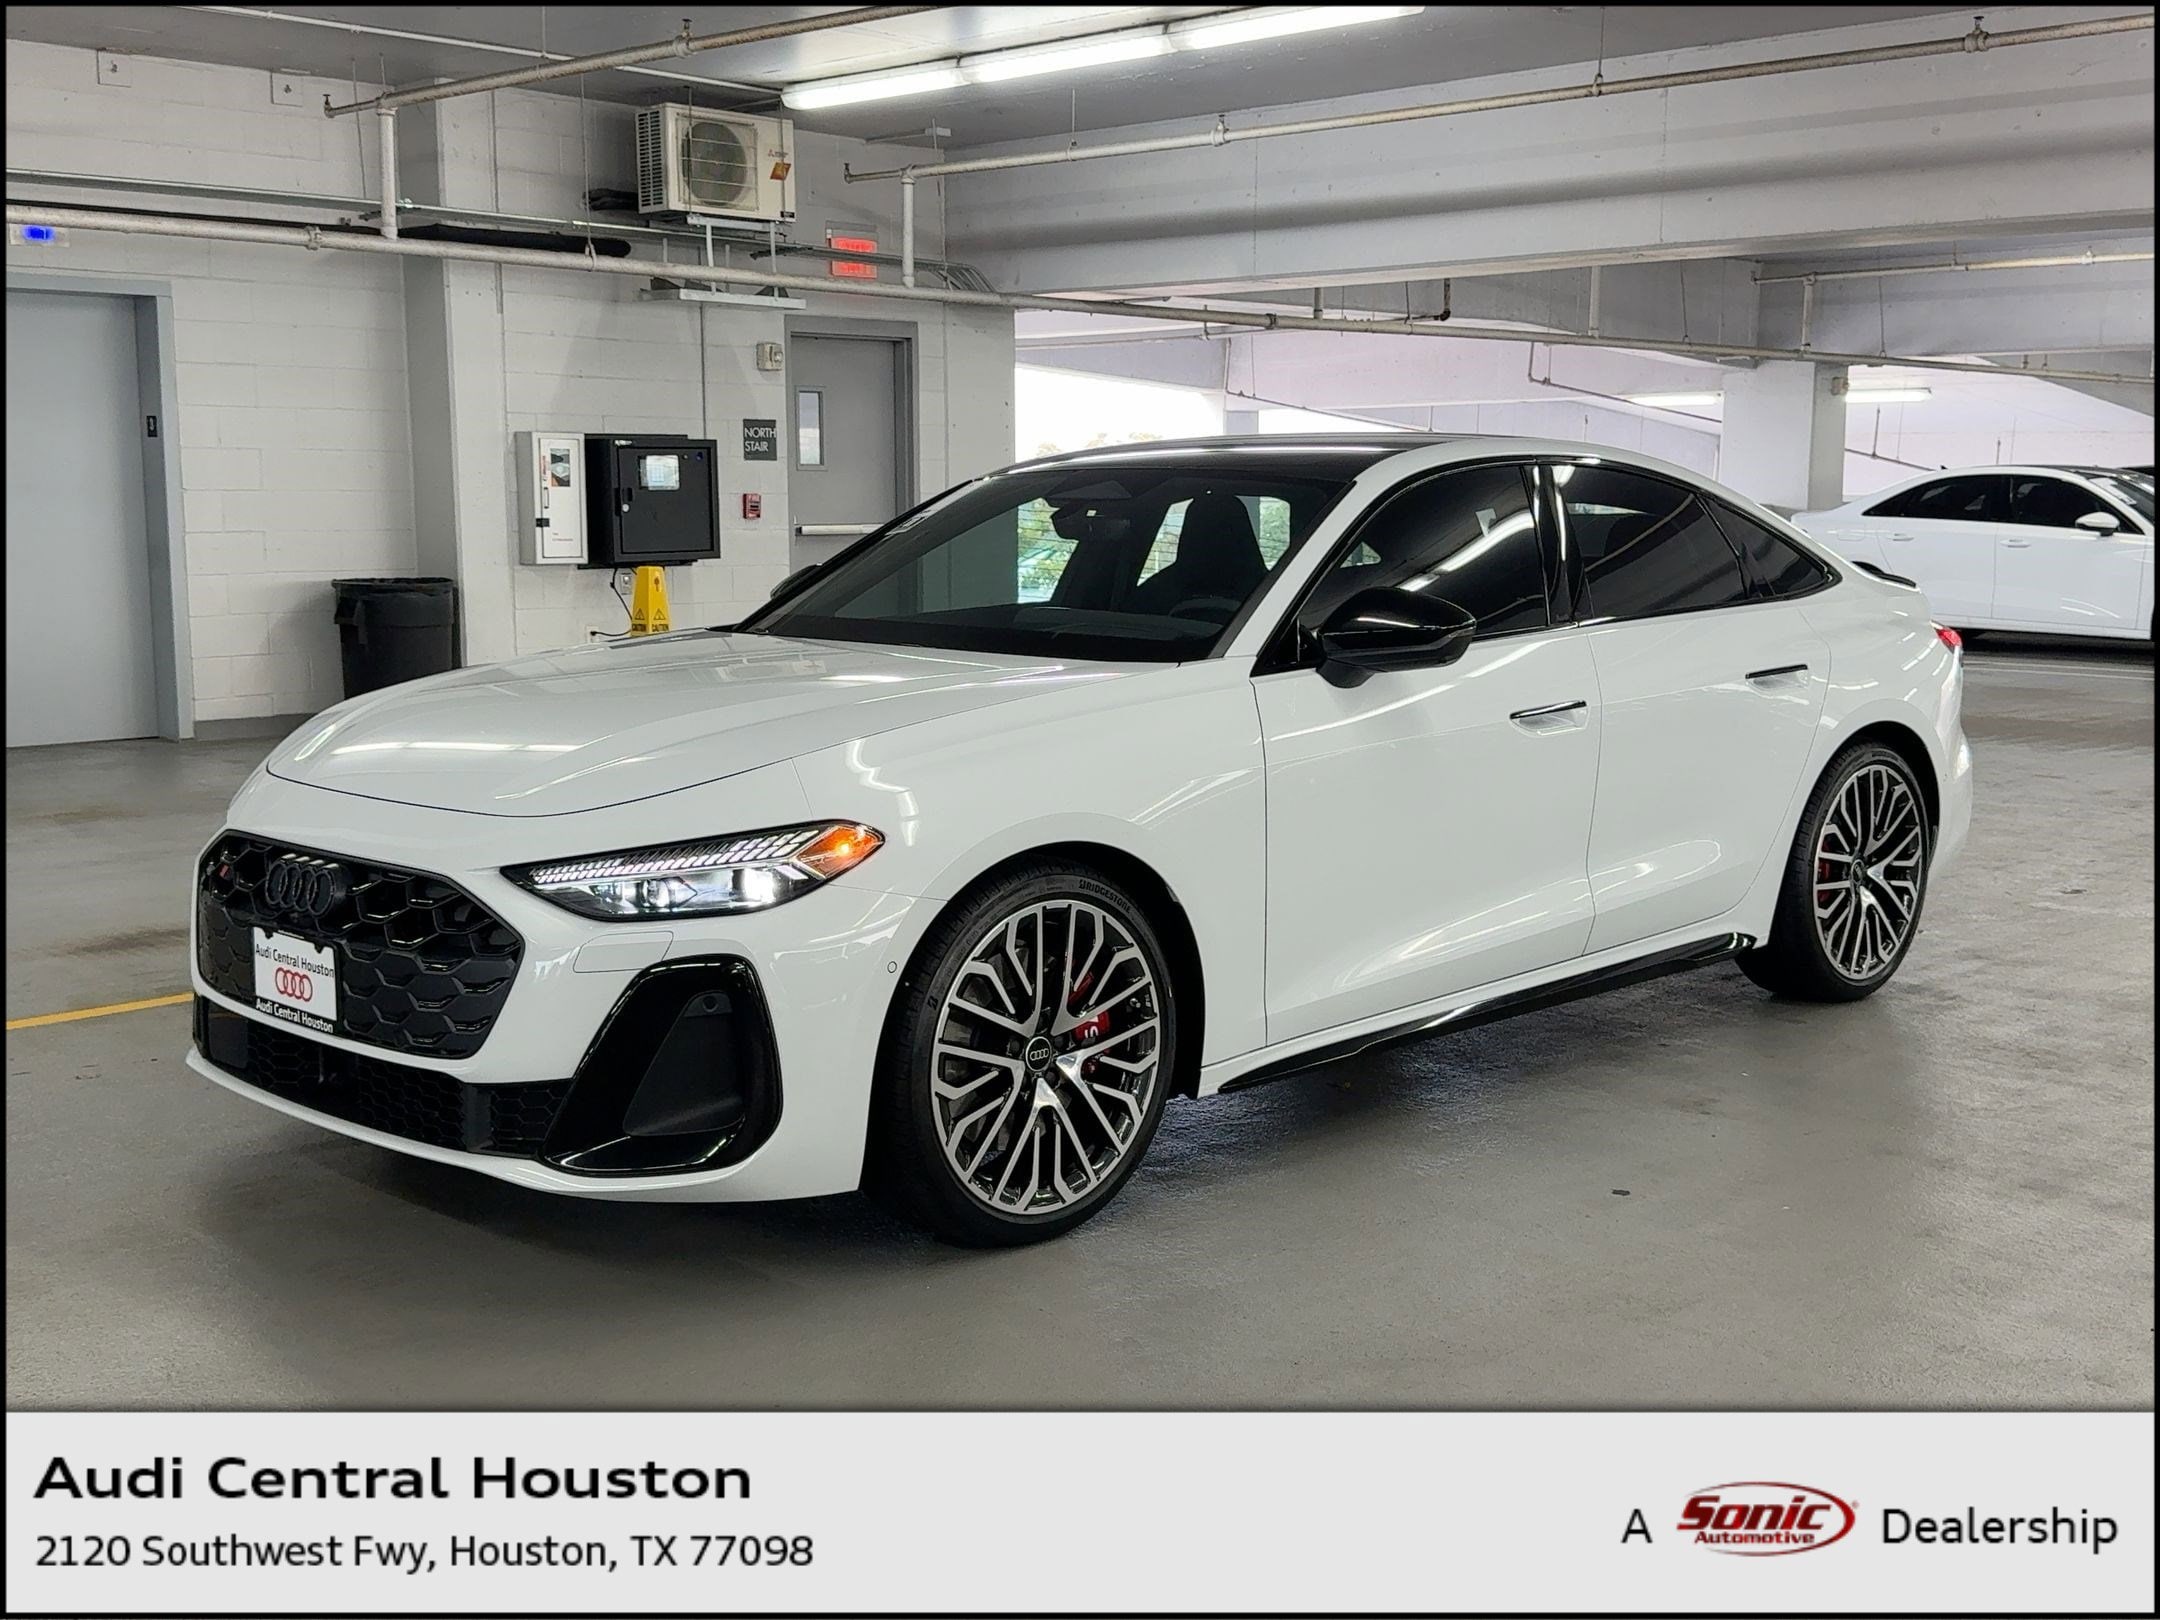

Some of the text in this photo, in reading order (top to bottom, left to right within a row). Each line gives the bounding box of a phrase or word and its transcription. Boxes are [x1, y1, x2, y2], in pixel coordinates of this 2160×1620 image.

[744, 427, 777, 438] NORTH
[744, 441, 769, 452] STAIR
[1078, 879, 1131, 914] BRIDGESTONE
[255, 943, 335, 978] Audi Central Houston
[256, 998, 334, 1034] Audi Central Houston
